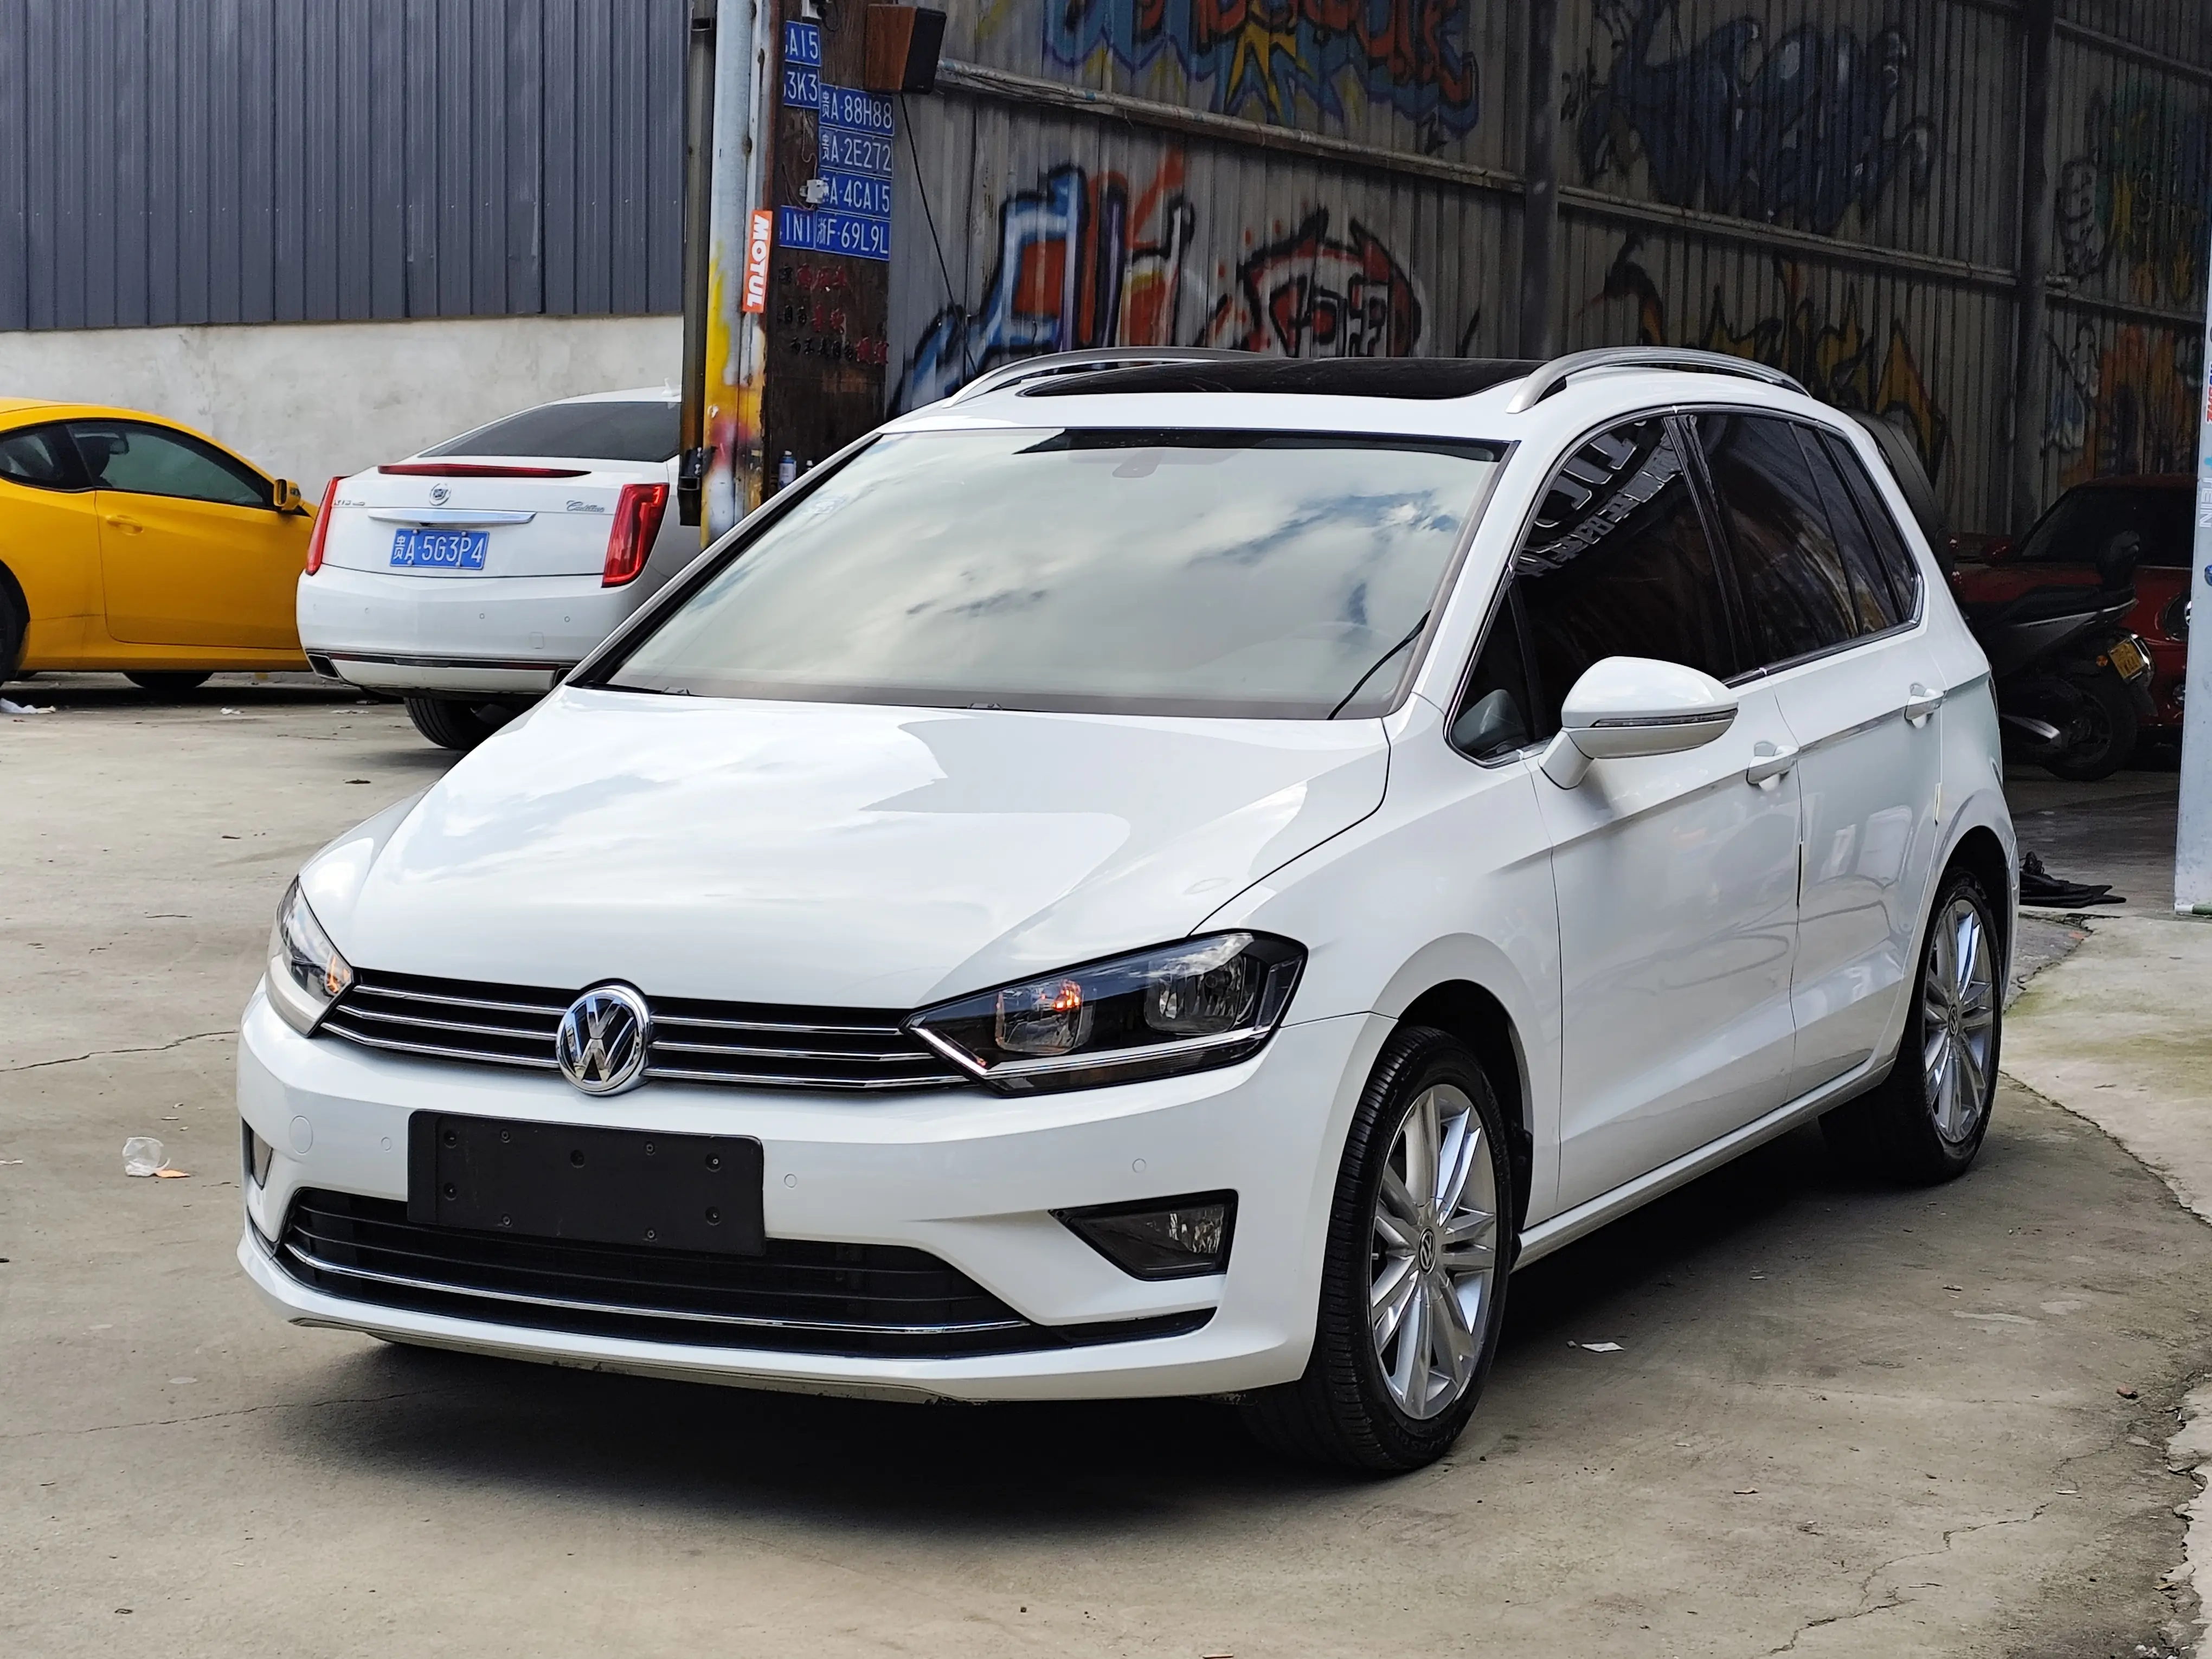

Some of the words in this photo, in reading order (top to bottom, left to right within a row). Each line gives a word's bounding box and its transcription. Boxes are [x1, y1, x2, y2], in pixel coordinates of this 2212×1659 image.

[785, 28, 819, 60] A15
[784, 71, 818, 102] 3K3
[779, 212, 810, 243] 1N1
[747, 214, 769, 307] MOTUL
